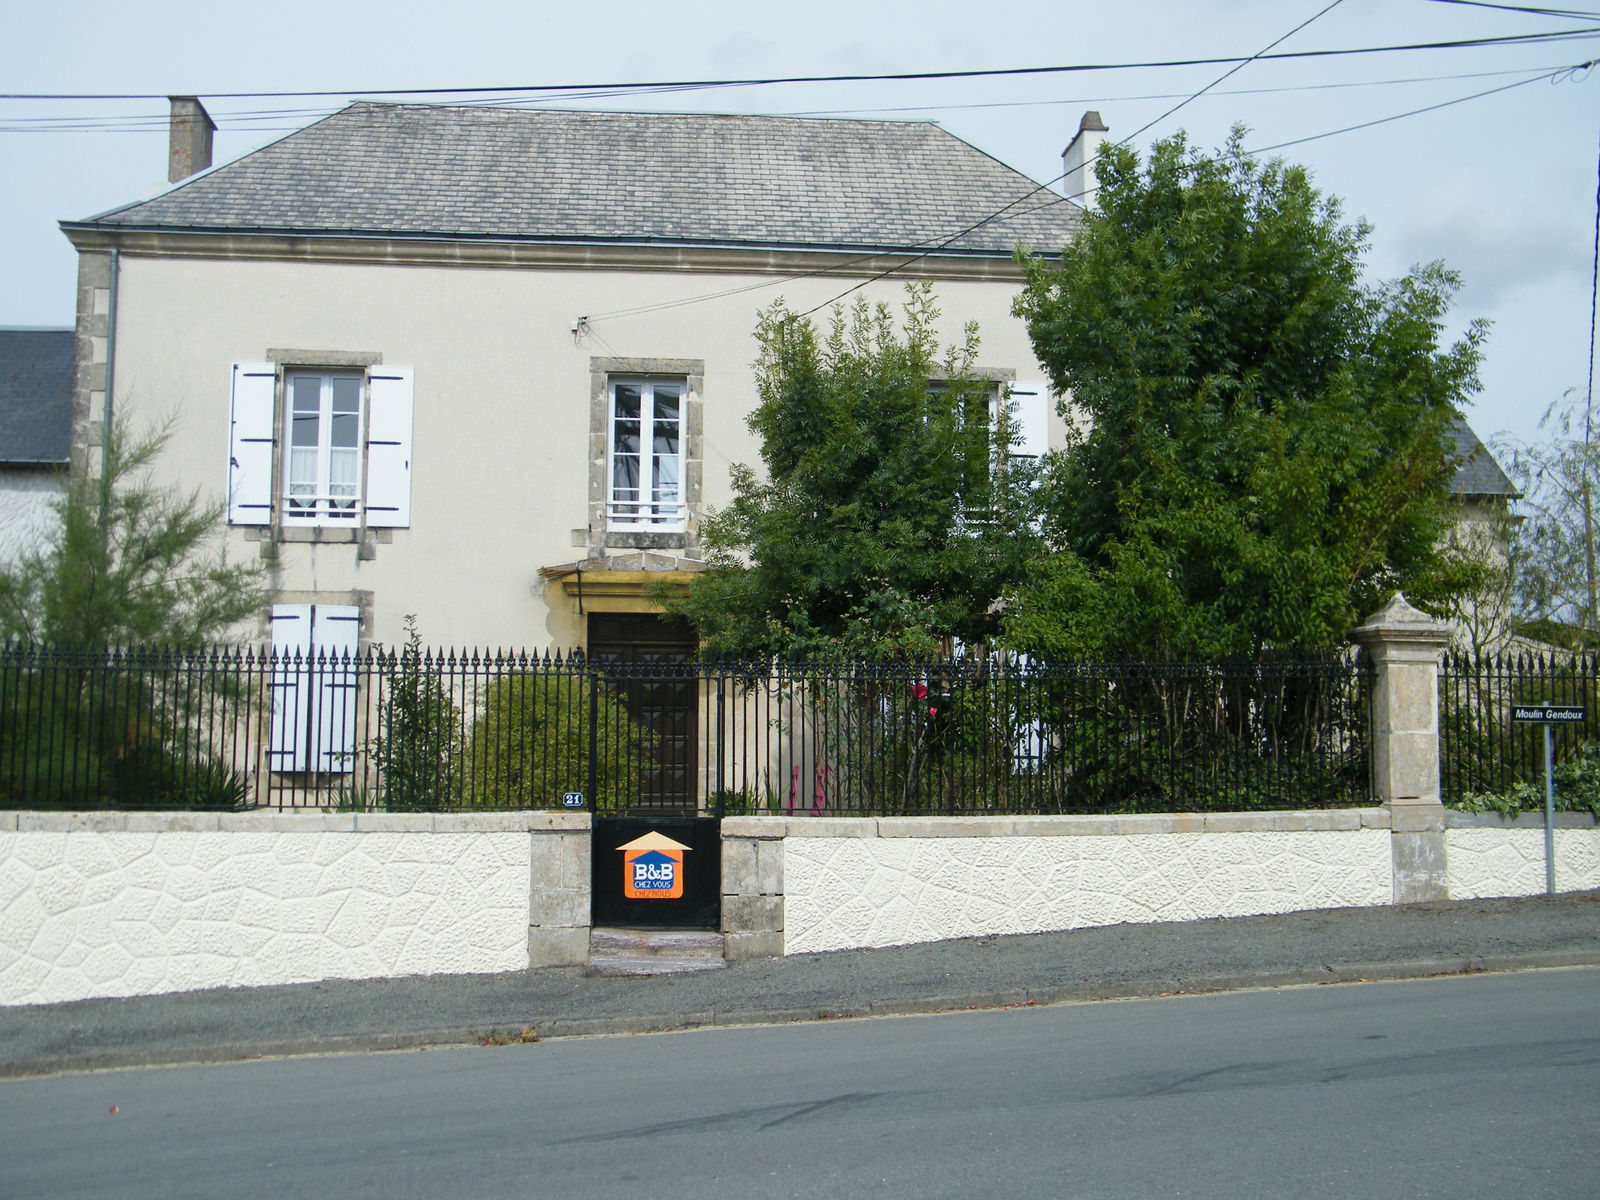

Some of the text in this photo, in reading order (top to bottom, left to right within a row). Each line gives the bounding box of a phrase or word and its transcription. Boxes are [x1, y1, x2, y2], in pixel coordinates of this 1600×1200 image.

[1515, 709, 1583, 719] Moulin Gendoux
[565, 794, 580, 804] 21
[634, 863, 673, 881] B&B
[634, 880, 671, 889] CHEZ VOUS
[634, 889, 671, 898] CHEZ NOUS
